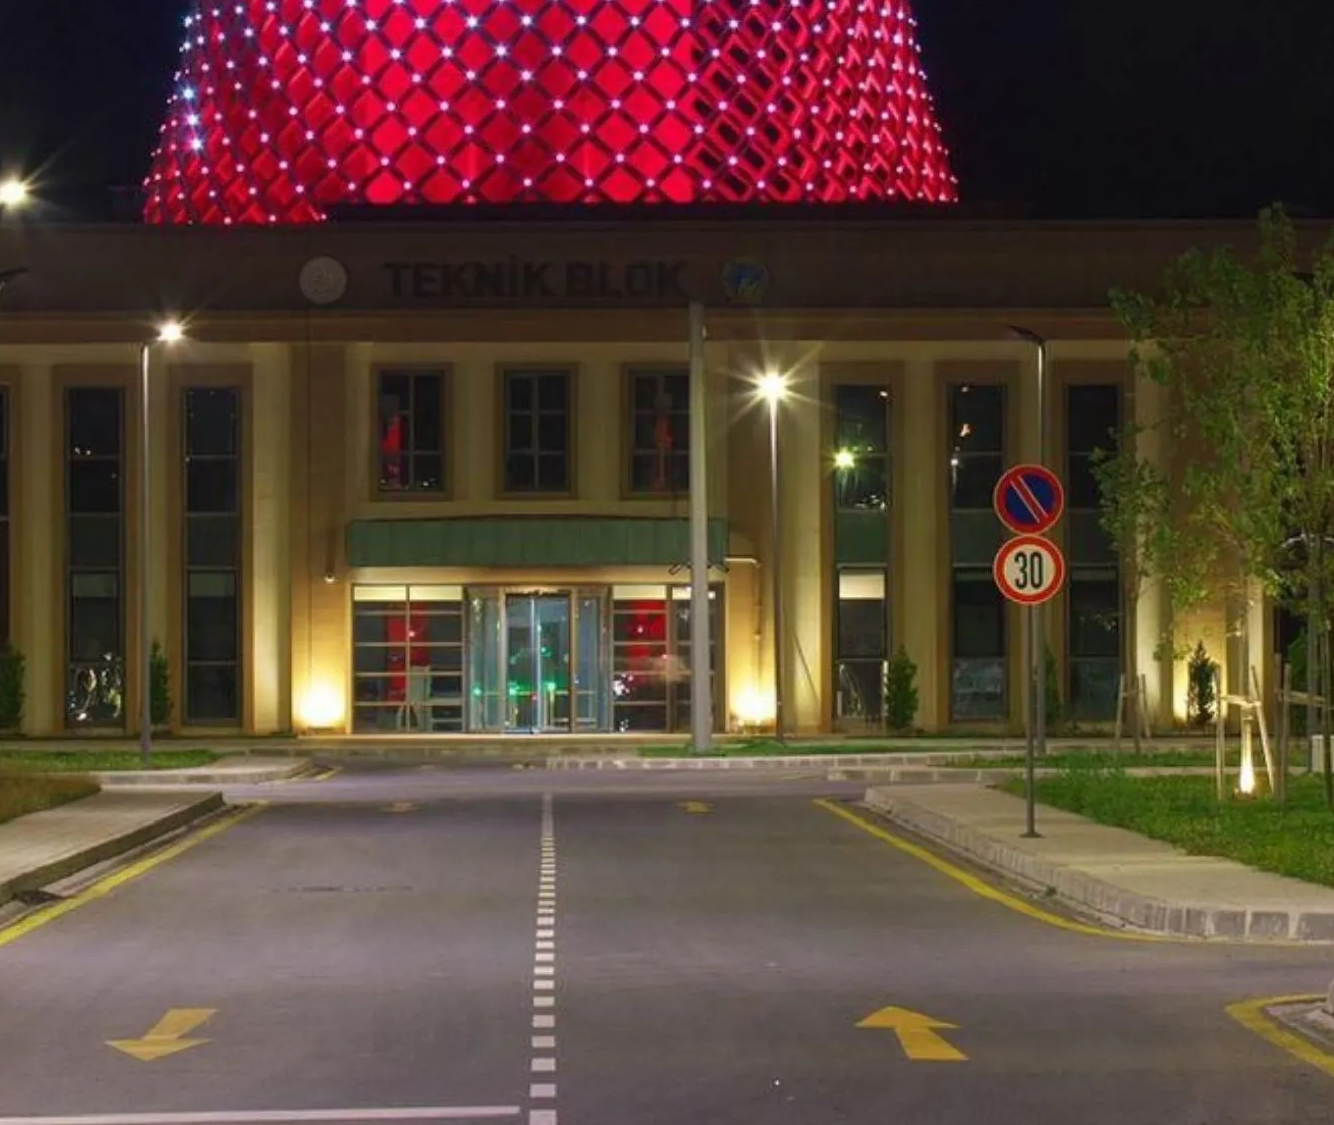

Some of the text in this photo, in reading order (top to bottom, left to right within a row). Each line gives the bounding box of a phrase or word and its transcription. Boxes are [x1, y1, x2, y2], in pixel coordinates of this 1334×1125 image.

[382, 253, 689, 298] TEKNİK BLOK
[1014, 551, 1043, 589] 30
